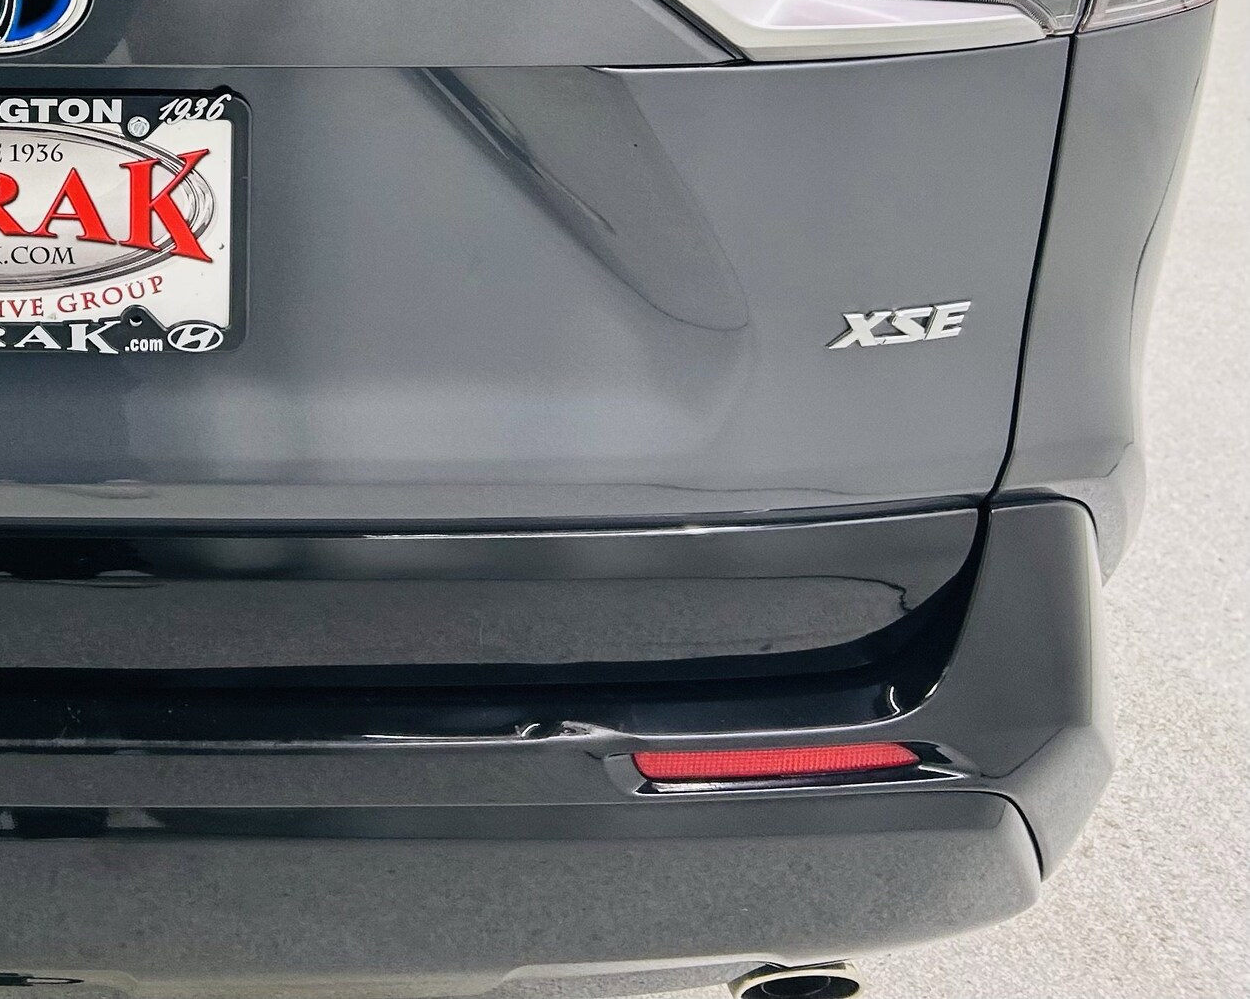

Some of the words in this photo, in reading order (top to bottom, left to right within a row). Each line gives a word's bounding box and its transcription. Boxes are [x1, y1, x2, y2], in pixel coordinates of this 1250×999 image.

[159, 94, 232, 121] 1936
[10, 142, 65, 164] 1936
[57, 276, 165, 314] GROUP
[825, 300, 972, 350] XSE
